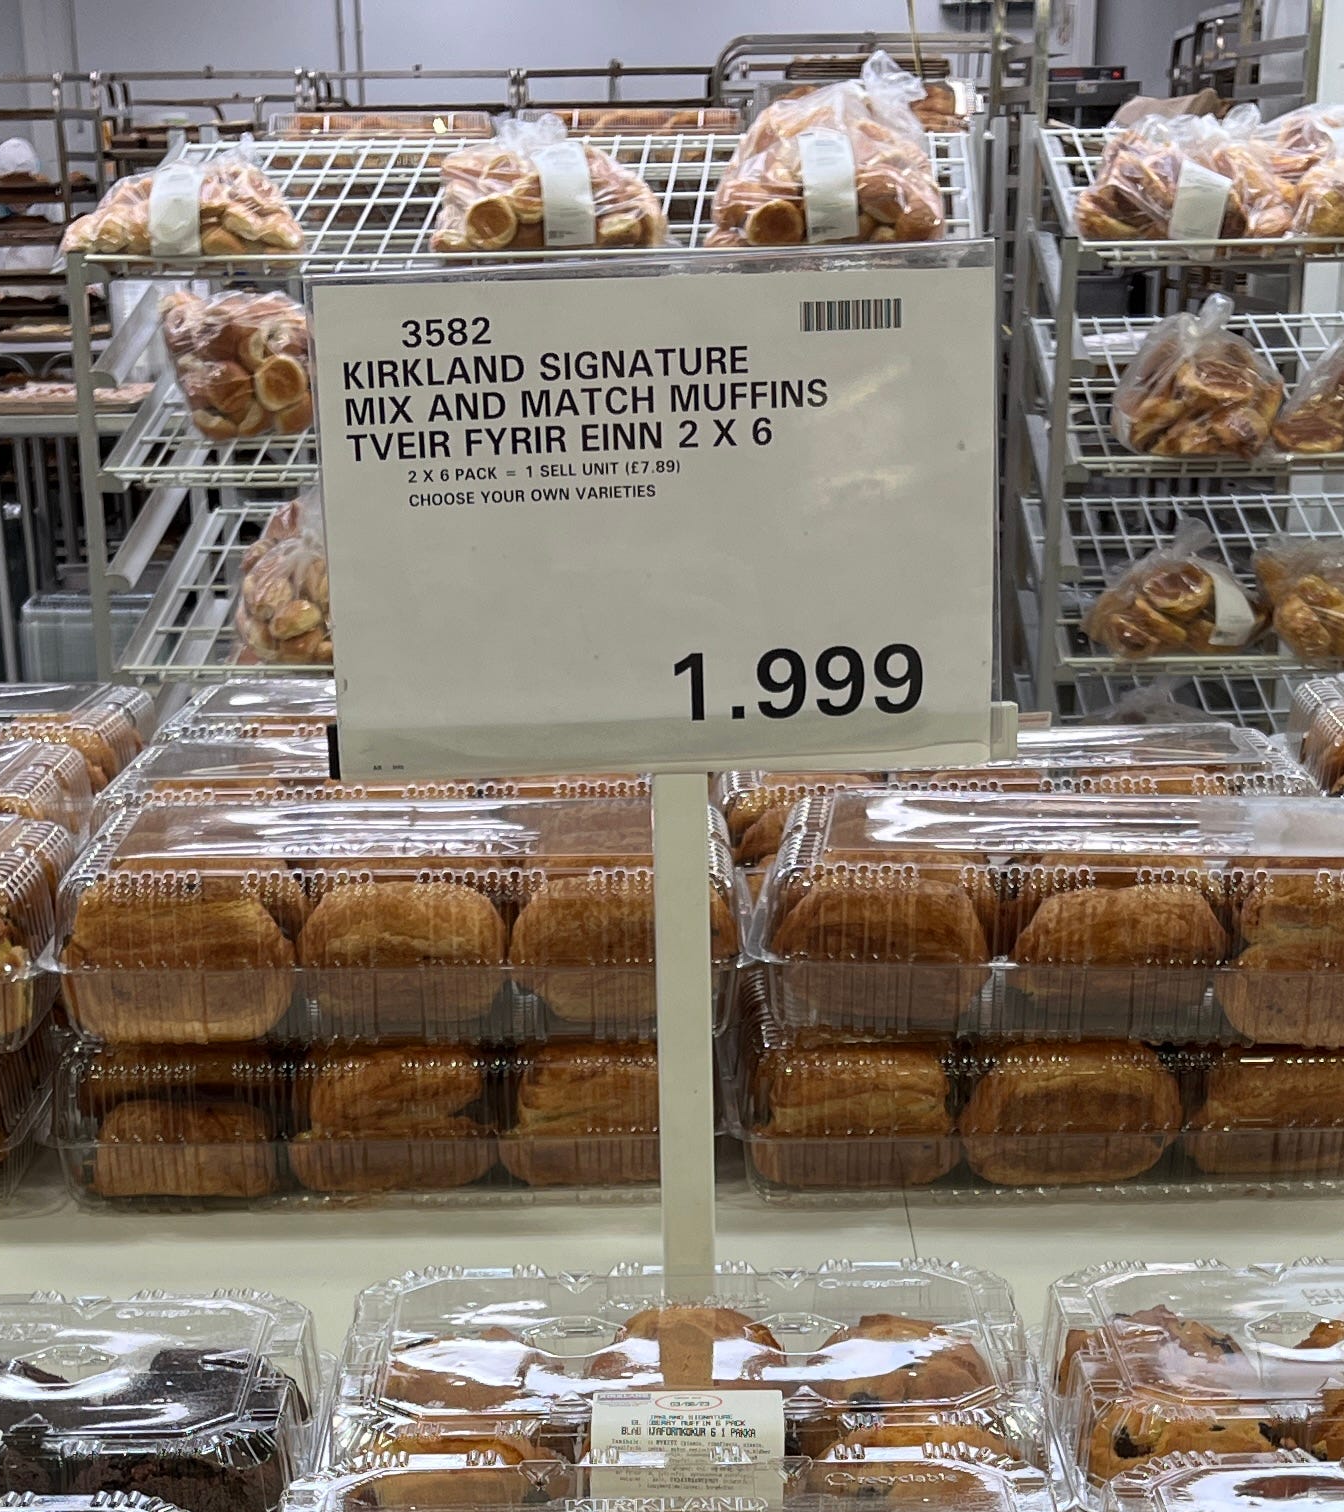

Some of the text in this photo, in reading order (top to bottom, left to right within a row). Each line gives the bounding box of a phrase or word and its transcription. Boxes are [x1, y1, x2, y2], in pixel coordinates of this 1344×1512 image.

[401, 317, 492, 349] 3582
[342, 346, 749, 390] KIRKLAND SIGNATURE
[345, 378, 829, 426] MIX AND MATCH MUFFINS
[347, 417, 773, 462] TVEIR FYRIR EINN 2 X 6
[408, 460, 681, 483] 2 X 6 PACK = 1 SELL UNIT (£7.89)
[409, 484, 657, 507] CHOOSE YOUR OWN VARIETIES
[672, 642, 924, 721] 1.999
